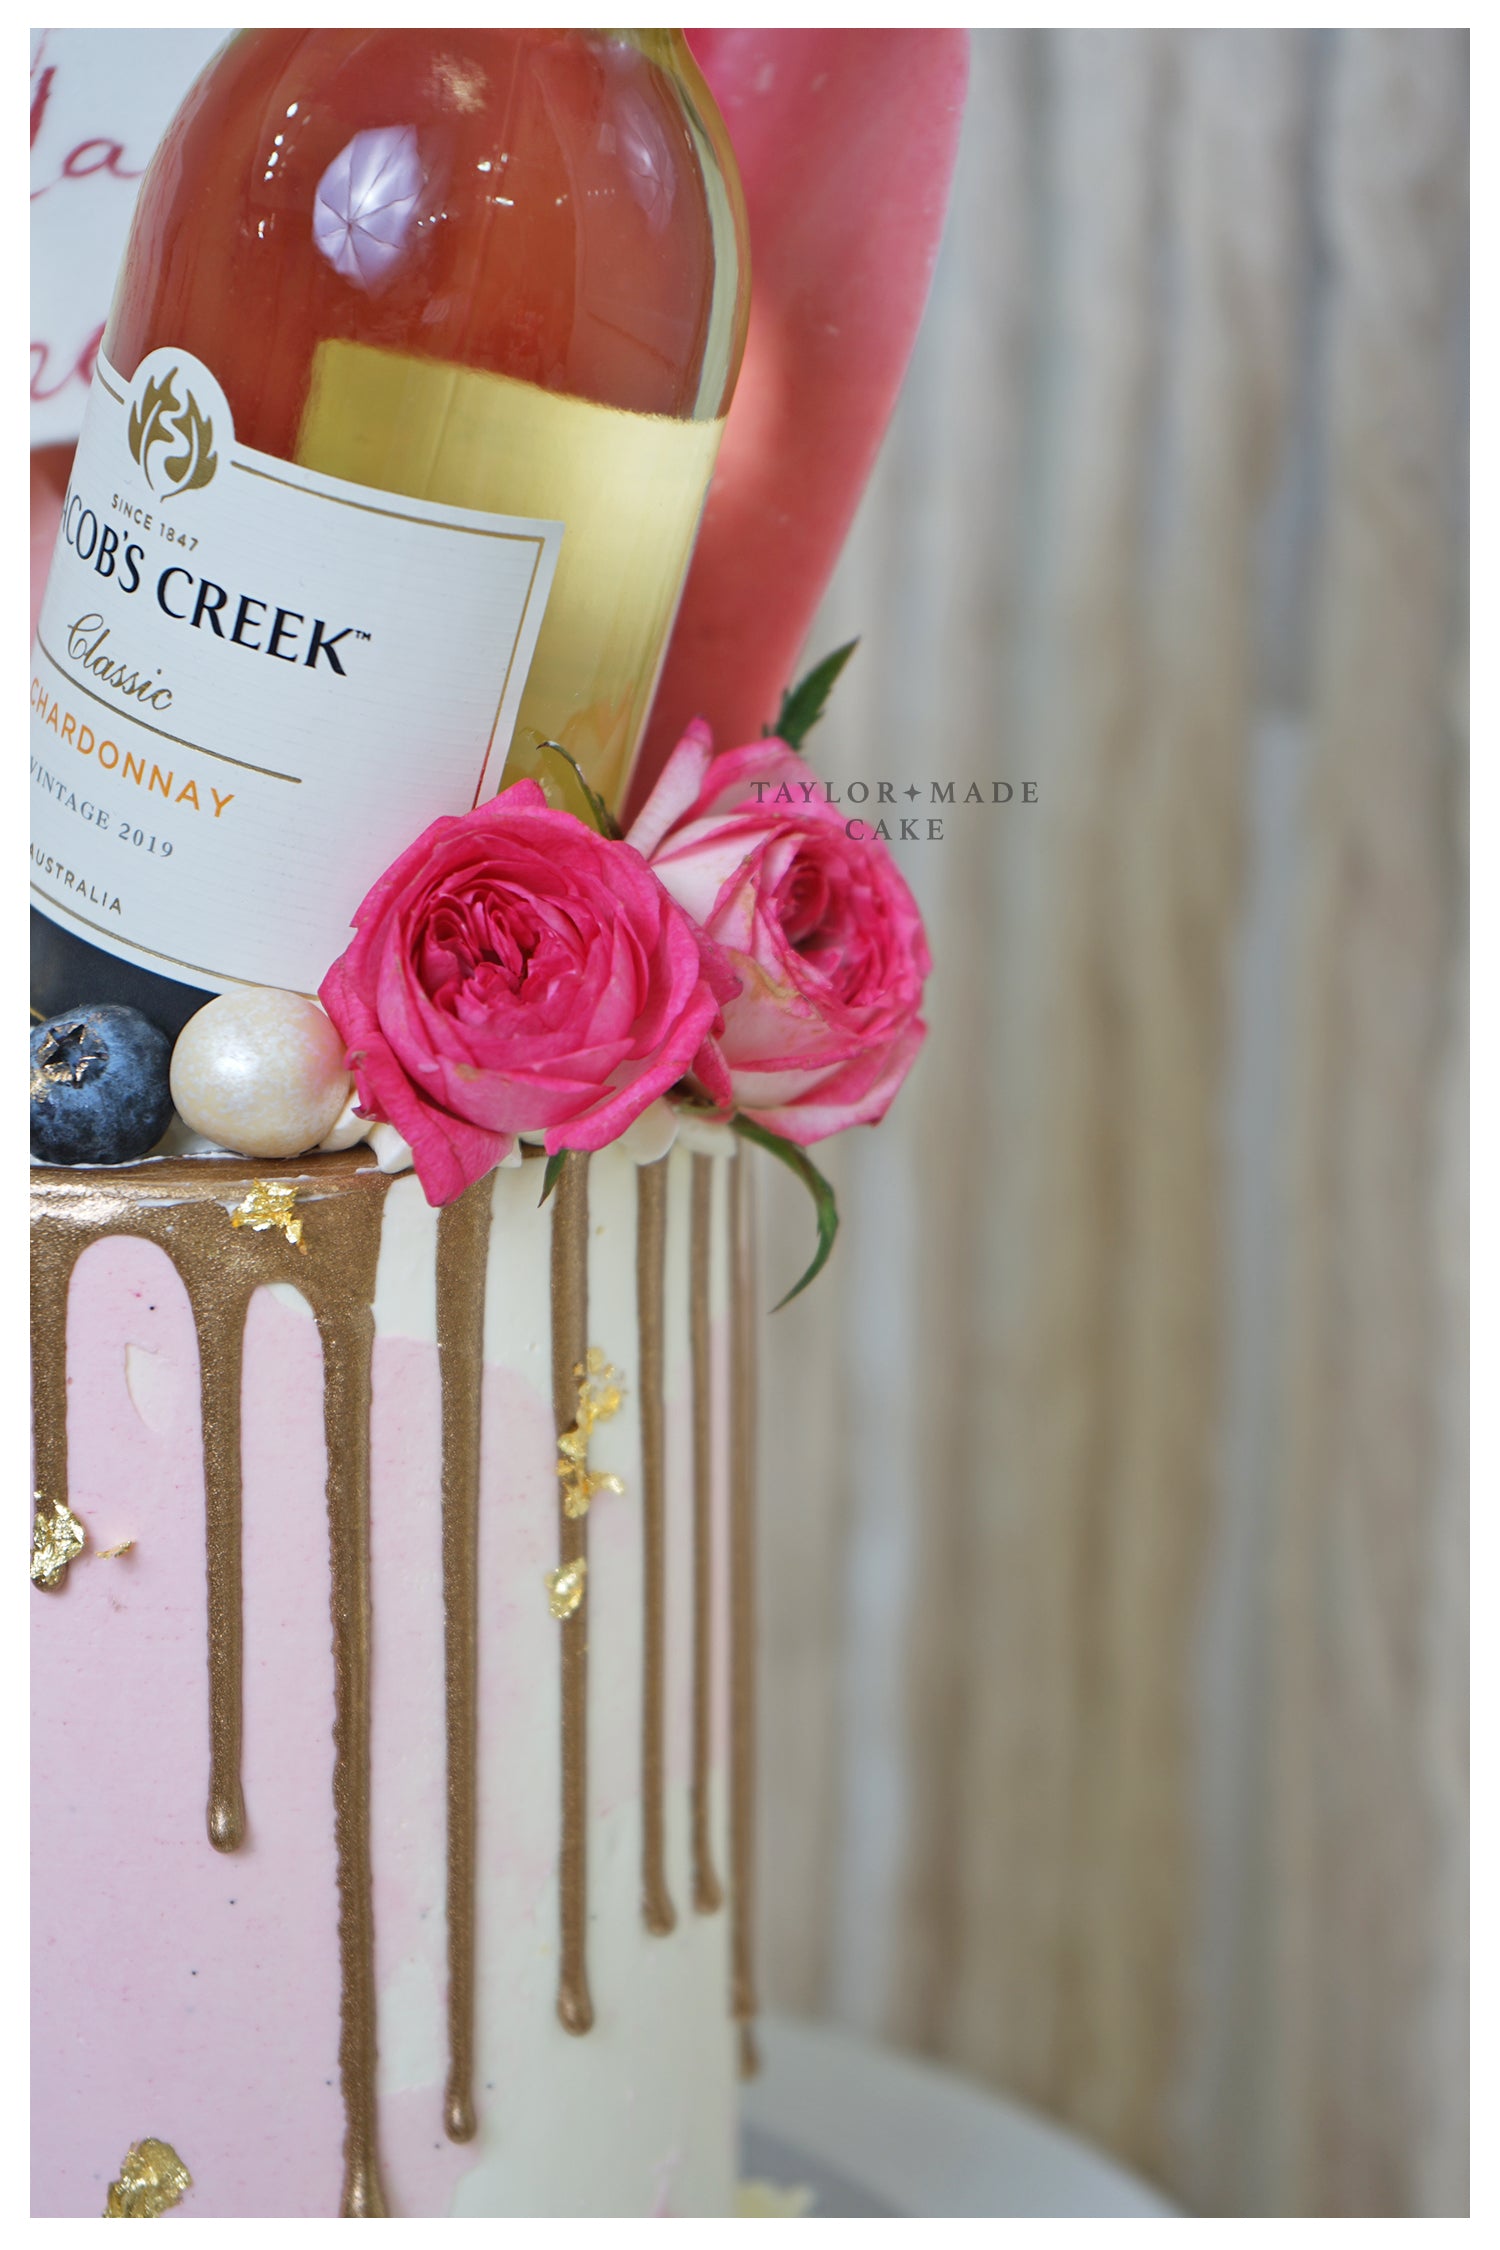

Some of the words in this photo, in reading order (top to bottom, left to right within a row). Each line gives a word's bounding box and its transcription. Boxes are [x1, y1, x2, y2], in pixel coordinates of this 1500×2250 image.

[112, 493, 153, 531] SINCE
[160, 523, 199, 552] 1847
[67, 613, 173, 711] Classic
[30, 677, 235, 818] CHARDONNAY
[30, 755, 110, 830] VINTAGE
[118, 822, 174, 858] 2019
